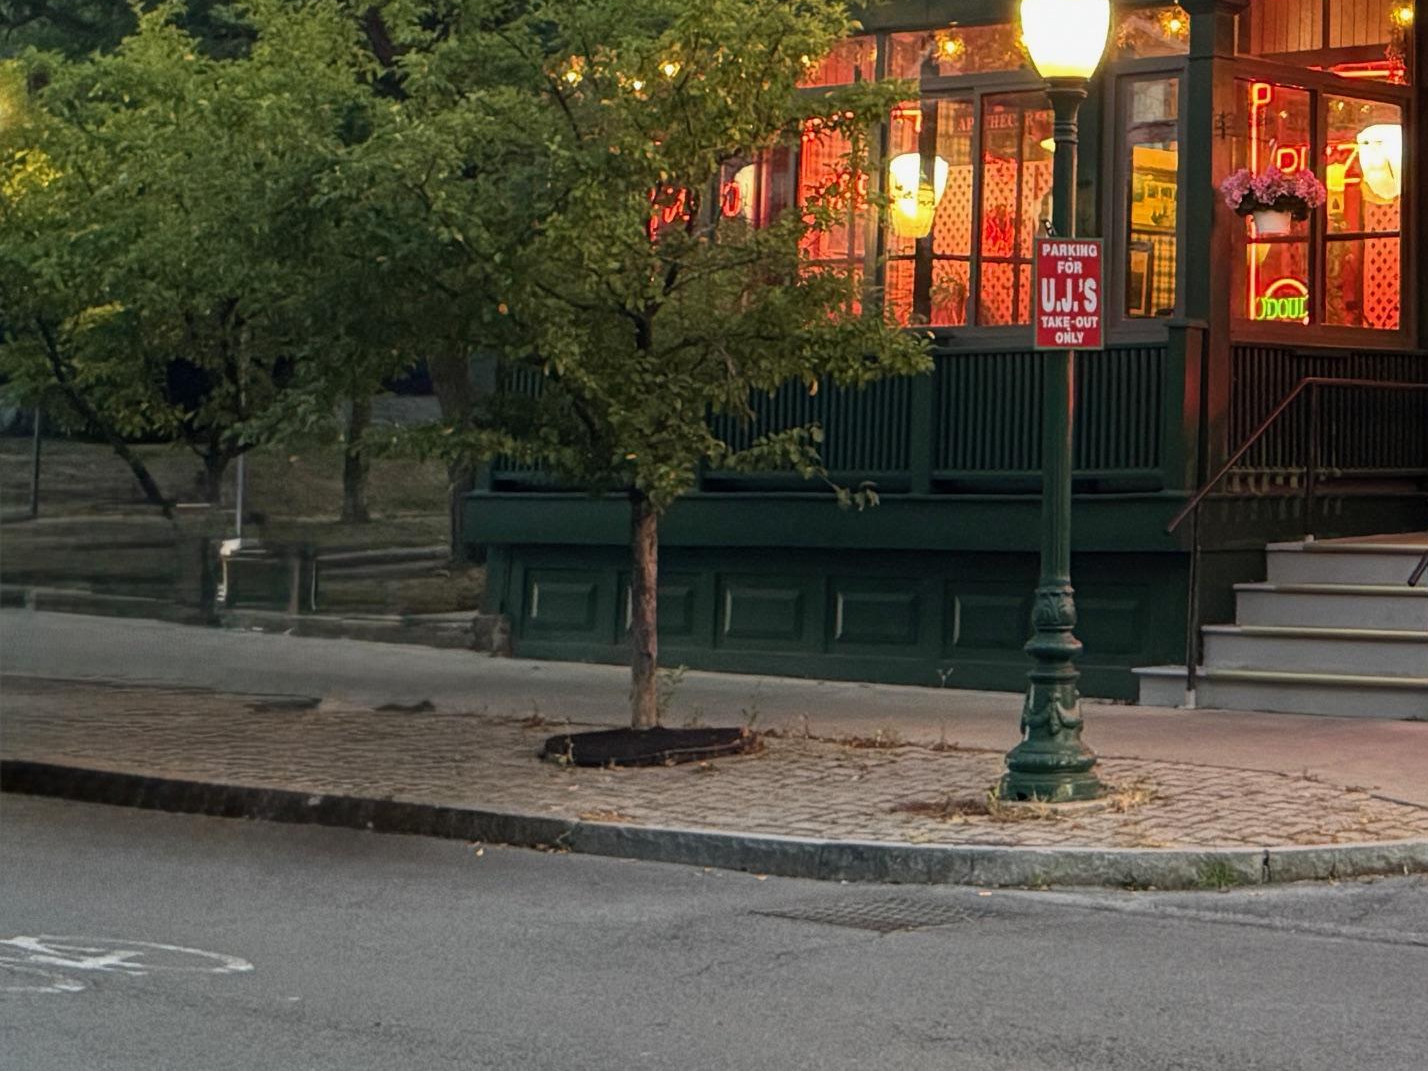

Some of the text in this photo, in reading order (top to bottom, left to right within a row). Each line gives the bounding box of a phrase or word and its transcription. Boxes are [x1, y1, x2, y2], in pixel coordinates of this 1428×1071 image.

[1042, 244, 1098, 257] PARKING
[1057, 261, 1083, 274] FOR
[1041, 277, 1097, 312] U.J.'S
[1041, 316, 1098, 328] TAKE-OUT
[1055, 332, 1084, 344] ONLY
